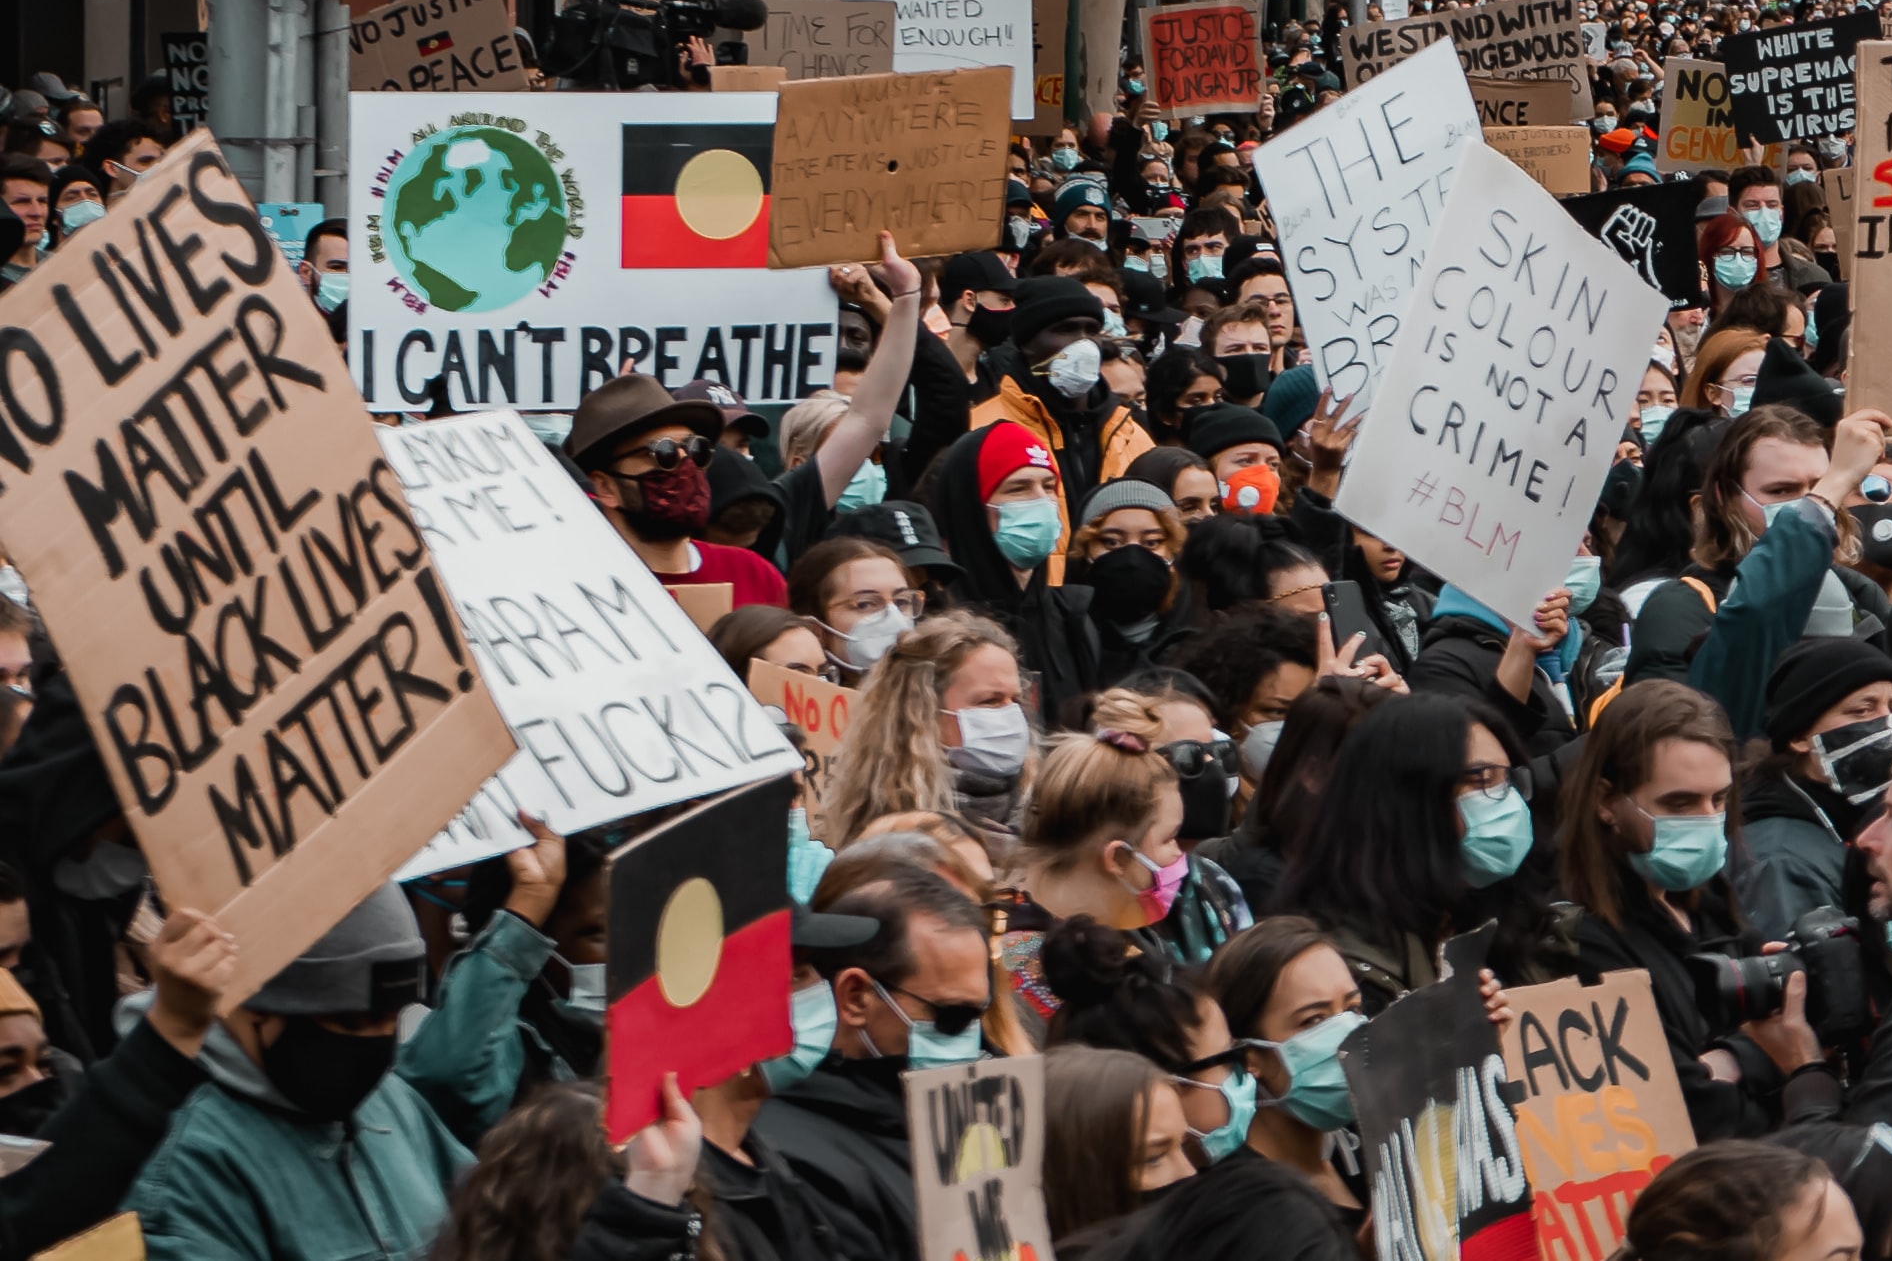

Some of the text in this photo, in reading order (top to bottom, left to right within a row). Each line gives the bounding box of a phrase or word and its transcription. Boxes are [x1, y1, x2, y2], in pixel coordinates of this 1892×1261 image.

[761, 10, 890, 51] TIME FOR
[900, 23, 1014, 48] ENOUGH!!
[1153, 7, 1258, 46] JUSTICE
[1158, 43, 1250, 70] FOR DAVID
[1349, 30, 1396, 61] WE
[1396, 12, 1495, 53] STAND
[1756, 28, 1835, 61] WHITE
[408, 33, 519, 91] PEACE
[1159, 70, 1262, 104] DUNGAY JR
[785, 102, 984, 148] ANYWHERE
[1766, 83, 1856, 116] IS THE
[1775, 108, 1856, 140] VIRUS
[905, 139, 996, 169] JUSTICE
[1284, 91, 1426, 220] THE
[780, 178, 1005, 248] EVERYWHERE
[52, 150, 277, 388] LIVES
[1333, 274, 1399, 328] WAS
[1478, 208, 1608, 335] SKIN
[360, 321, 835, 407] I CAN'T BREATHE
[1431, 265, 1620, 421] COLOUR
[1424, 323, 1588, 457] IS NOT A
[63, 293, 328, 581] MATTER
[139, 447, 322, 635] UNTIL
[1406, 470, 1523, 572] #BLM
[103, 457, 430, 817] BLACK LIVES
[207, 566, 475, 888] MATTER!
[516, 695, 734, 811] FUCK
